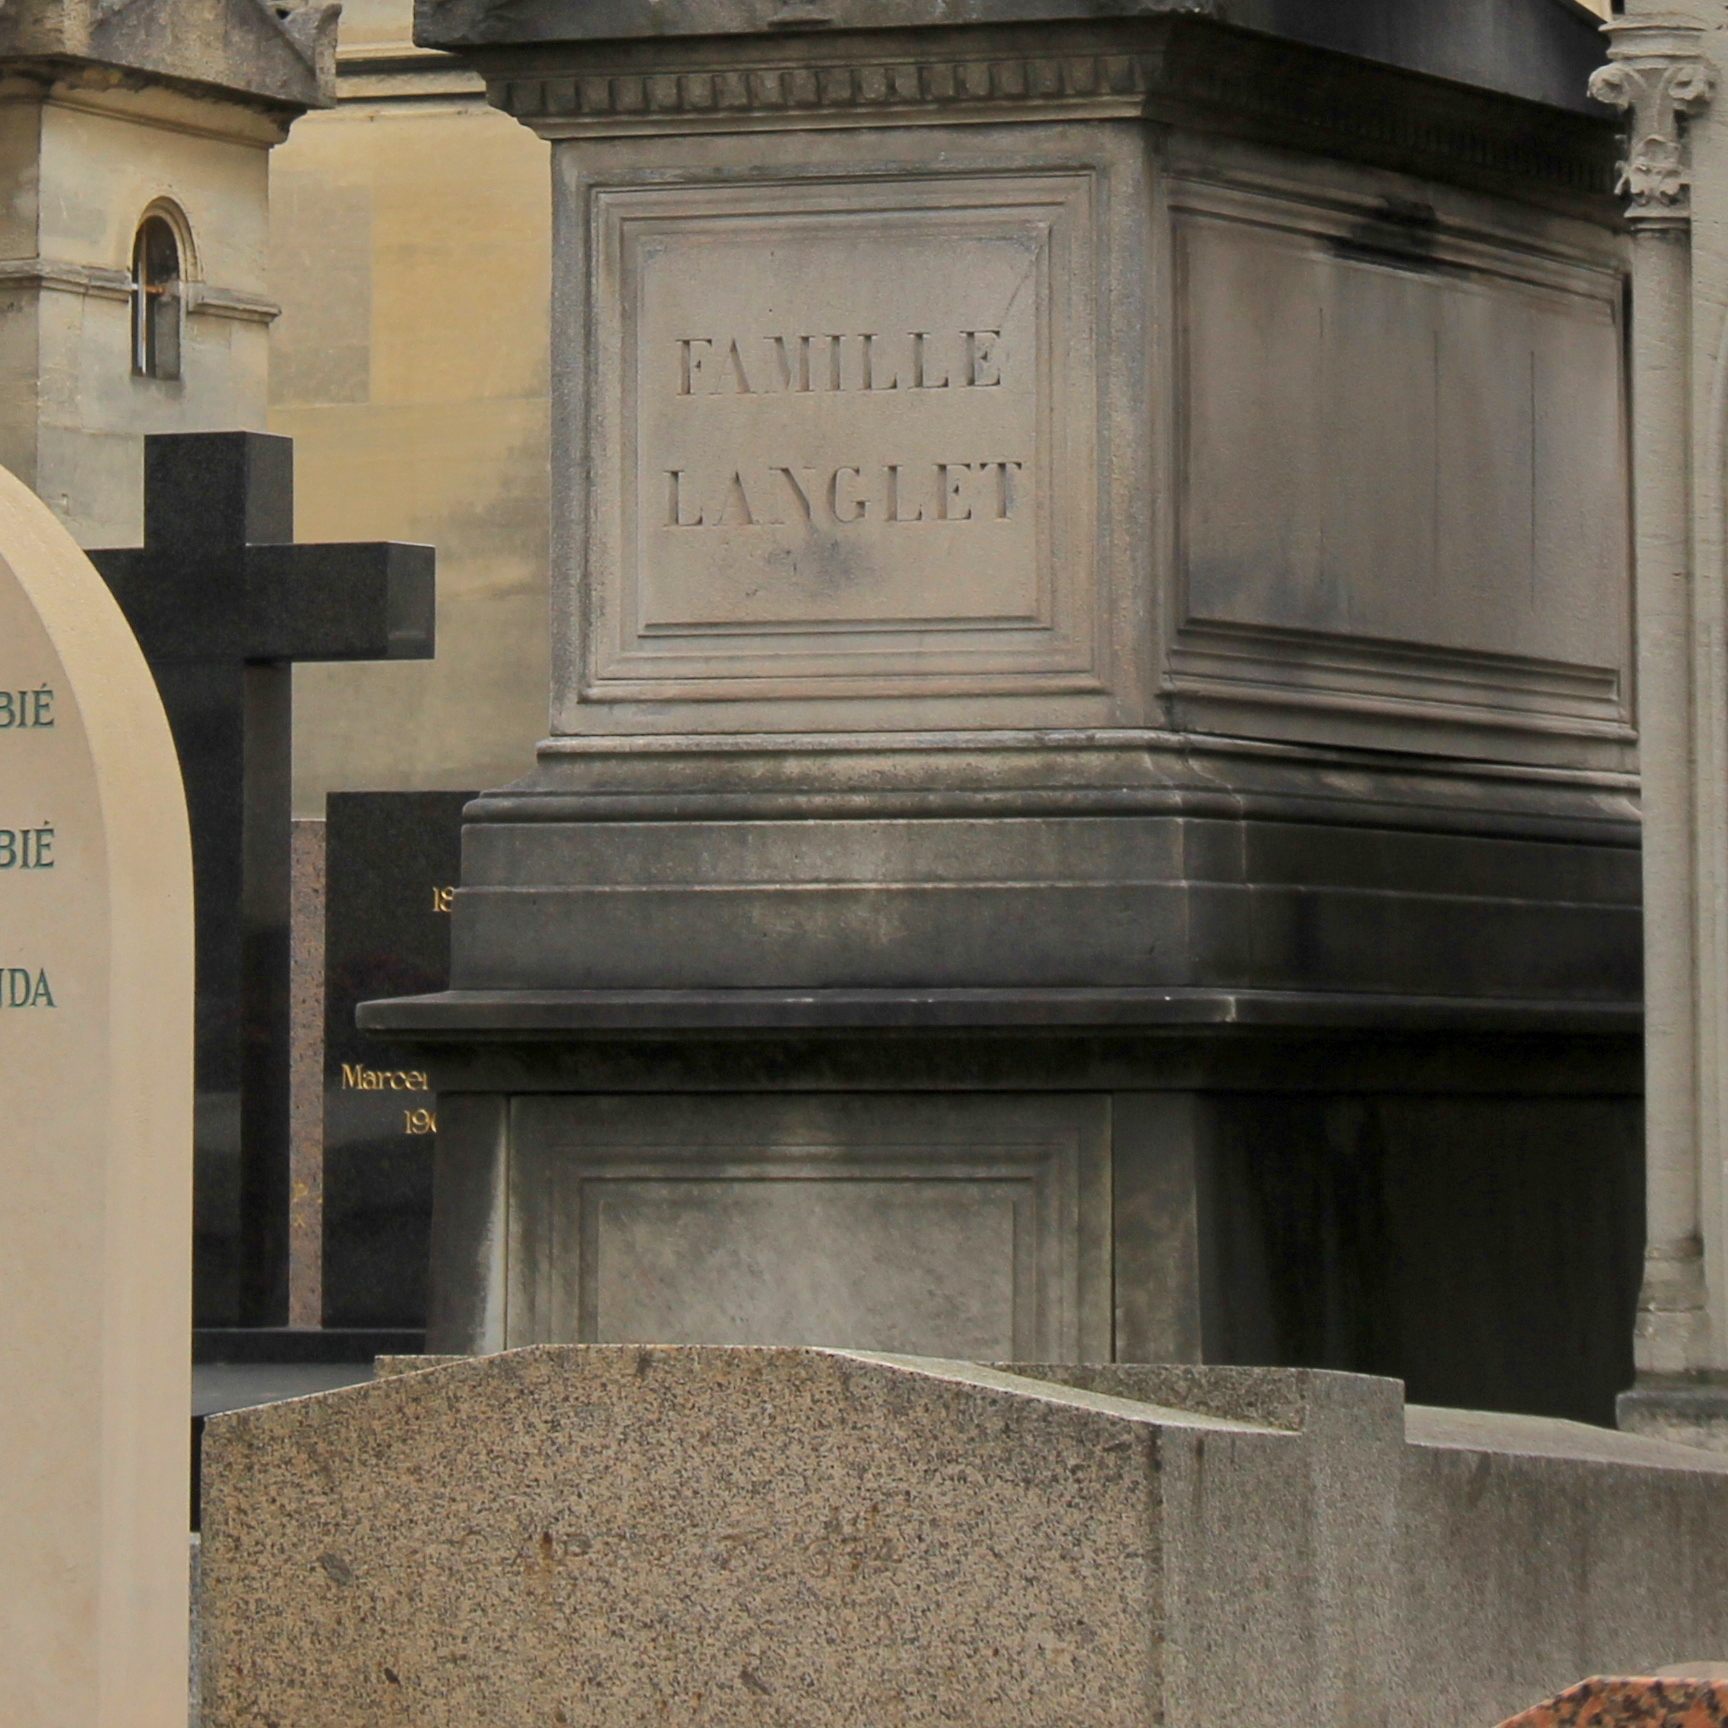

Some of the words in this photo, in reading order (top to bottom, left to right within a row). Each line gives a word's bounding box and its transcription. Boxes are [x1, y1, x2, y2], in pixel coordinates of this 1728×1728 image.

[675, 330, 1002, 396] FAMILLE
[663, 461, 1022, 527] LANGLET
[404, 1108, 437, 1134] 19
